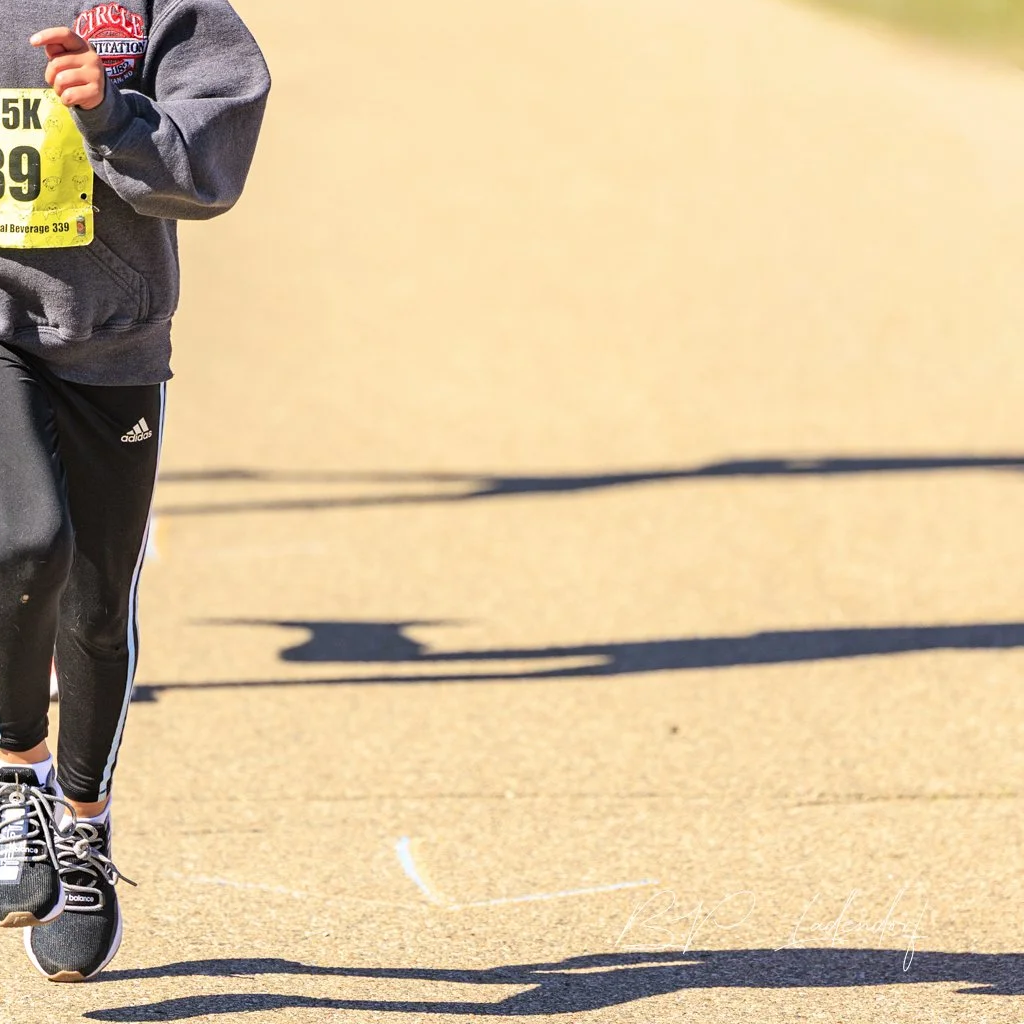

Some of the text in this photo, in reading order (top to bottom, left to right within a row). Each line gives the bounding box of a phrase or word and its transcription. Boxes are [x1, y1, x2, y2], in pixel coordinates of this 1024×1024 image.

[75, 2, 144, 39] CIRCLE
[2, 98, 42, 130] 5K
[10, 223, 50, 234] Beverage
[52, 222, 70, 232] 339
[120, 430, 153, 442] adidas
[68, 893, 95, 903] balance
